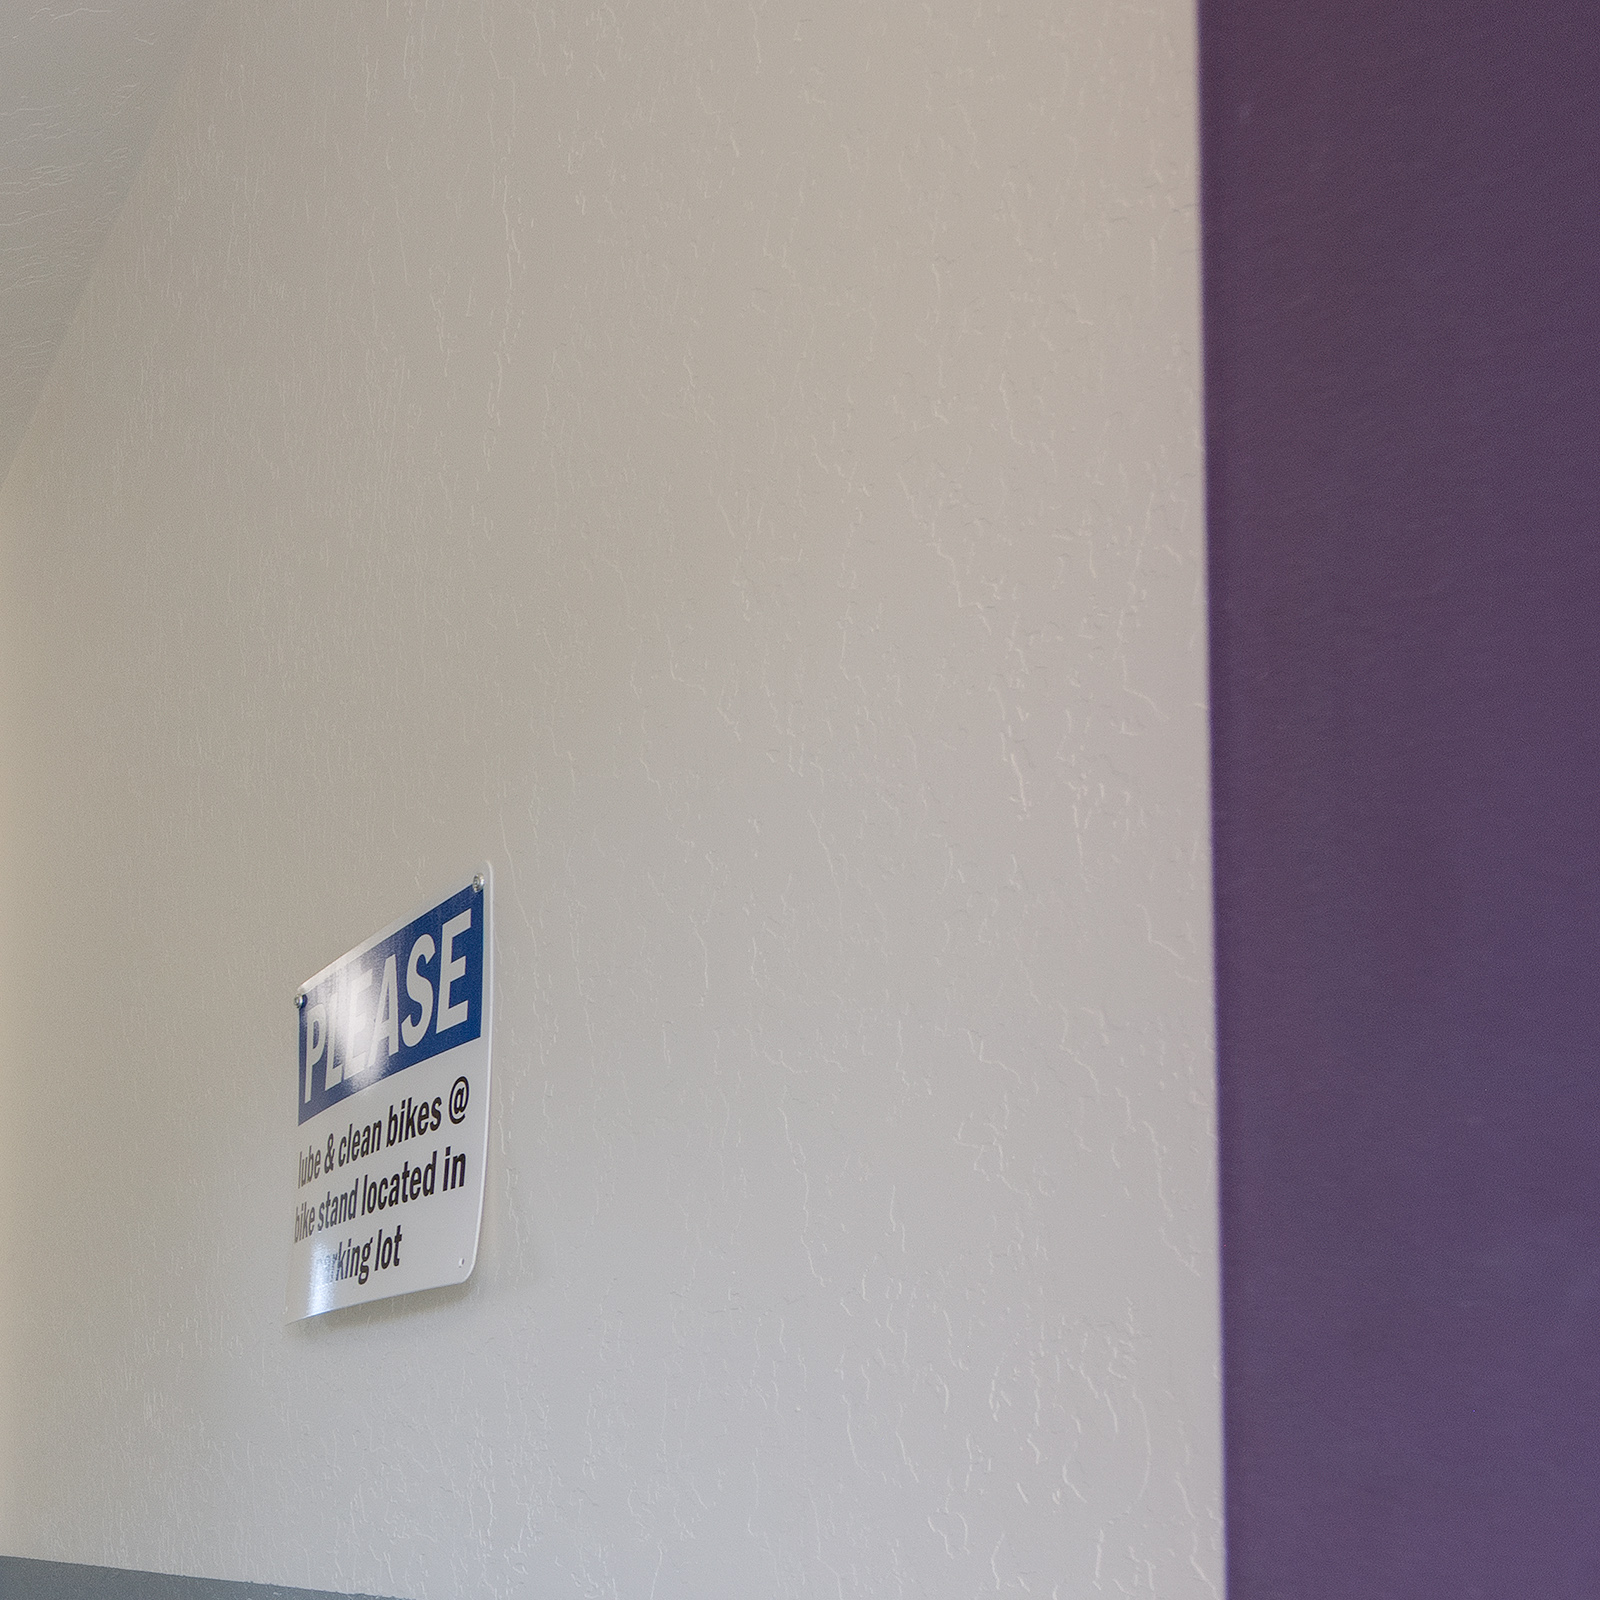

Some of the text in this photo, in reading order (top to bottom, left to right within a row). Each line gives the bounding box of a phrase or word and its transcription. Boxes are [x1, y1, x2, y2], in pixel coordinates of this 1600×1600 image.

[304, 908, 472, 1104] PLEASE
[297, 1076, 470, 1190] lube & clean bikes @
[294, 1146, 467, 1243] bike stand located in
[317, 1225, 403, 1286] rking lot
